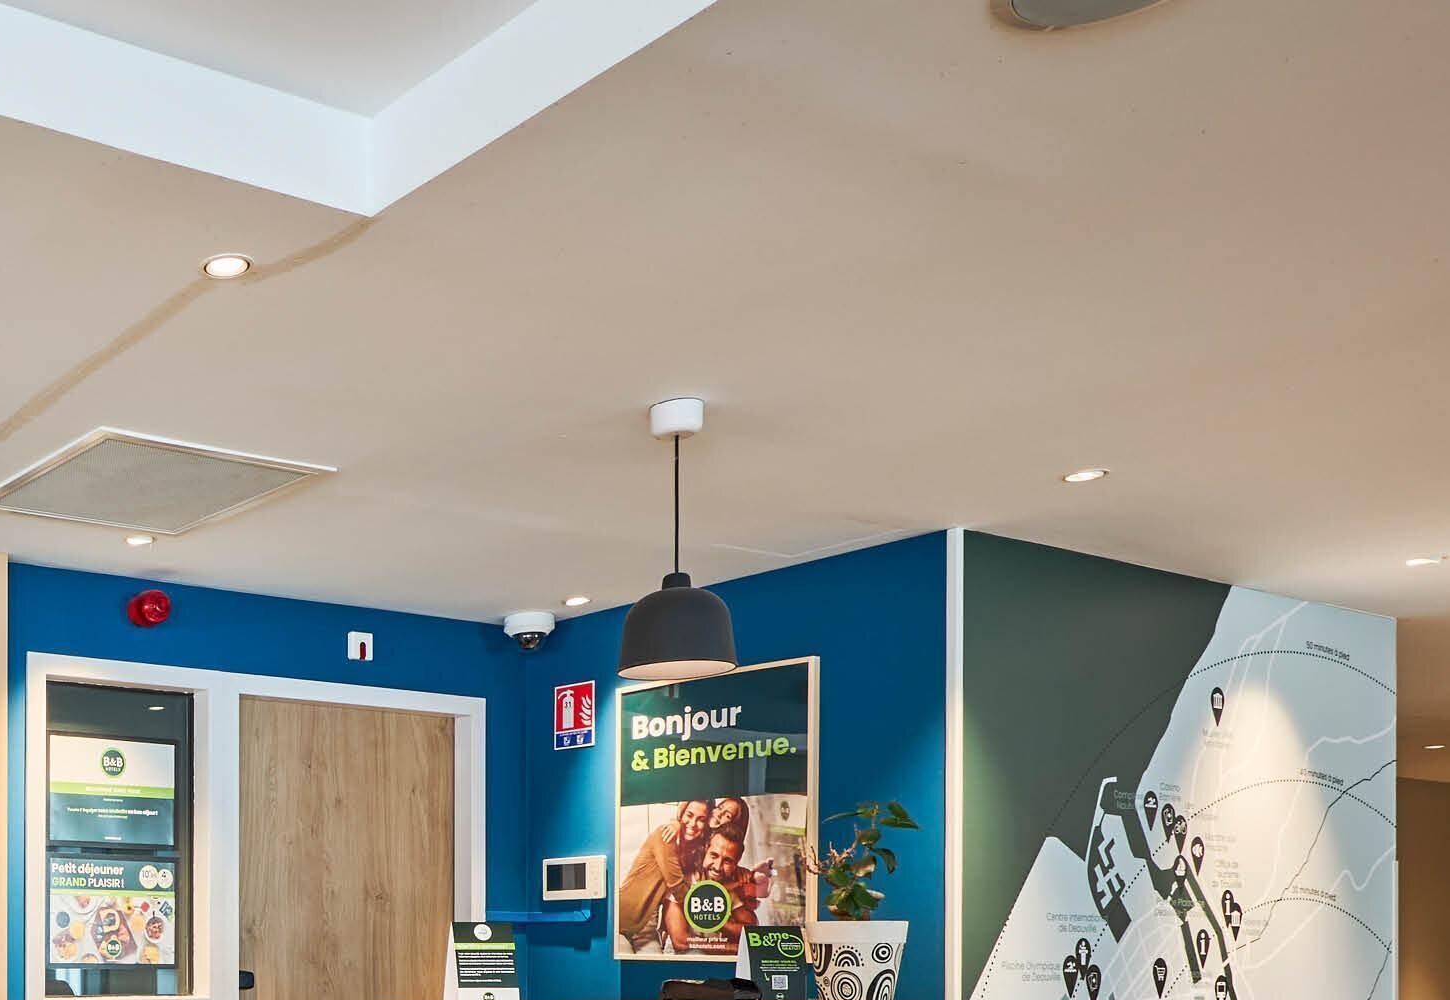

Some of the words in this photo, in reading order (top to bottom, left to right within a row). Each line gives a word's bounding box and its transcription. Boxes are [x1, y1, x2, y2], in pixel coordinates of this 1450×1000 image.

[632, 704, 742, 741] Bonjour
[632, 750, 650, 772] &
[654, 736, 797, 770] Bienvenue.
[103, 756, 123, 767] B&B
[52, 863, 76, 873] Petit
[78, 864, 124, 877] déjeuner
[53, 877, 86, 887] GRAND
[88, 879, 120, 888] PLAISIR
[690, 897, 725, 913] B&B
[748, 933, 789, 946] B&me
